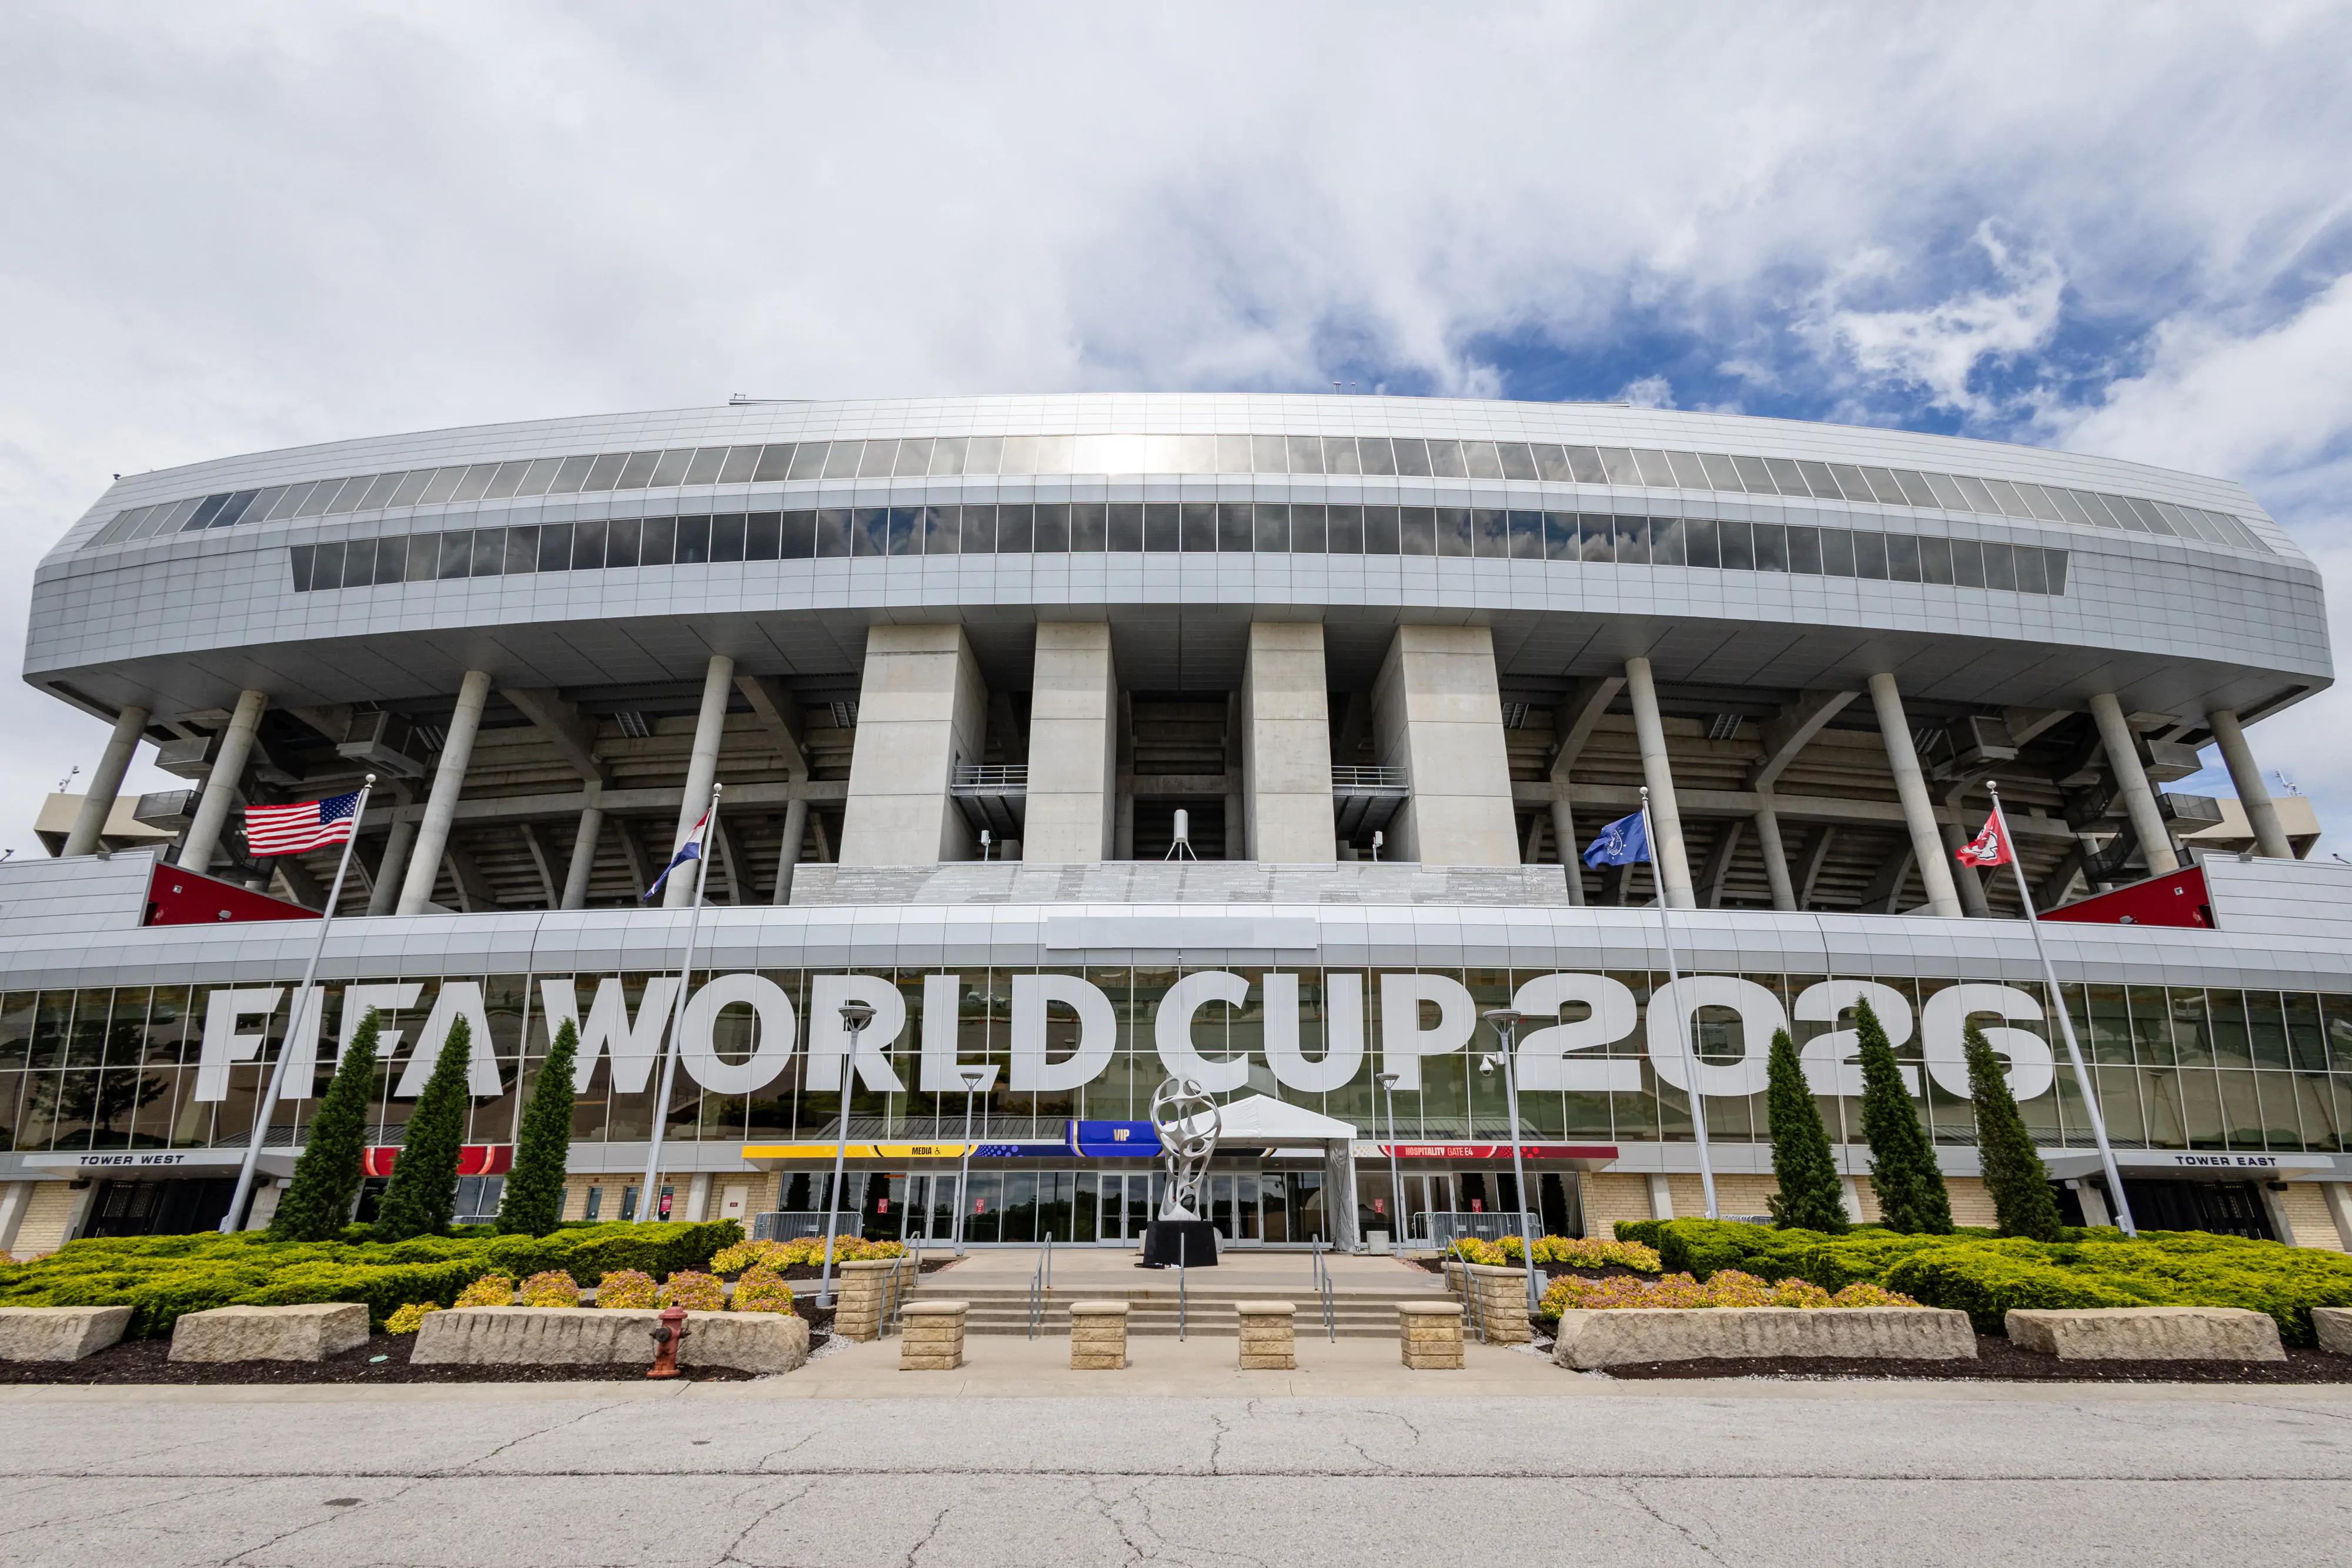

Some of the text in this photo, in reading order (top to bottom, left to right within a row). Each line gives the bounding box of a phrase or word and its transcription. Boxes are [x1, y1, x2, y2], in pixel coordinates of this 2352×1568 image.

[195, 970, 2054, 1102] FIFA WORLD CUP 2026
[1113, 1129, 1130, 1141] VIP
[911, 1146, 932, 1155] MEDIA
[1405, 1147, 1474, 1156] HOSPITALITY GATE E4
[80, 1155, 185, 1165] TOWER WEST
[2174, 1156, 2276, 1166] TOWER EAST
